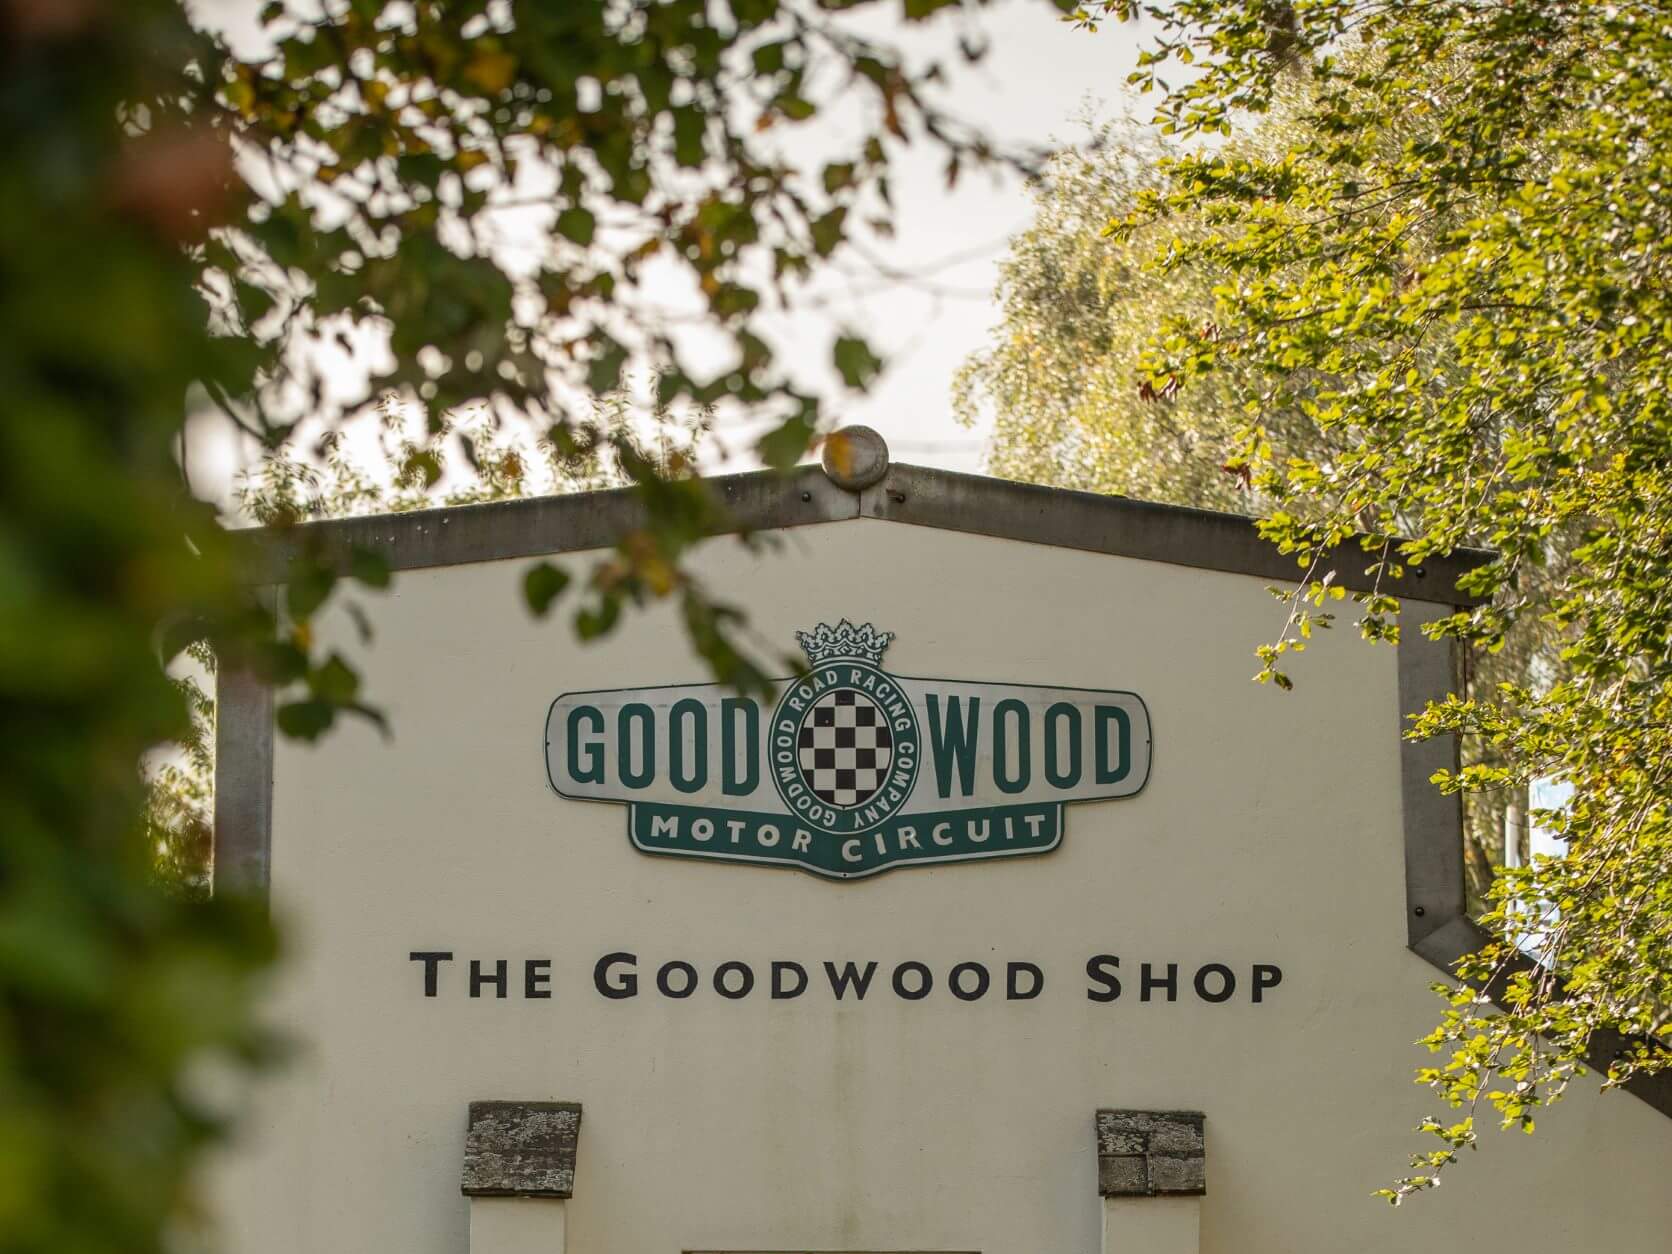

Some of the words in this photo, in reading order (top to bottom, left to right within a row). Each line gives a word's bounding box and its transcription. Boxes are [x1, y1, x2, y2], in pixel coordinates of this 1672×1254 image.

[789, 670, 838, 711] ROAD
[850, 669, 911, 732] RACING
[567, 698, 760, 796] GOOD
[925, 693, 1131, 799] WOOD
[777, 720, 836, 827] GOODWOOD
[853, 742, 914, 828] COMPANY
[651, 815, 812, 852] MOTOR
[841, 814, 1045, 862] CIRCUIT
